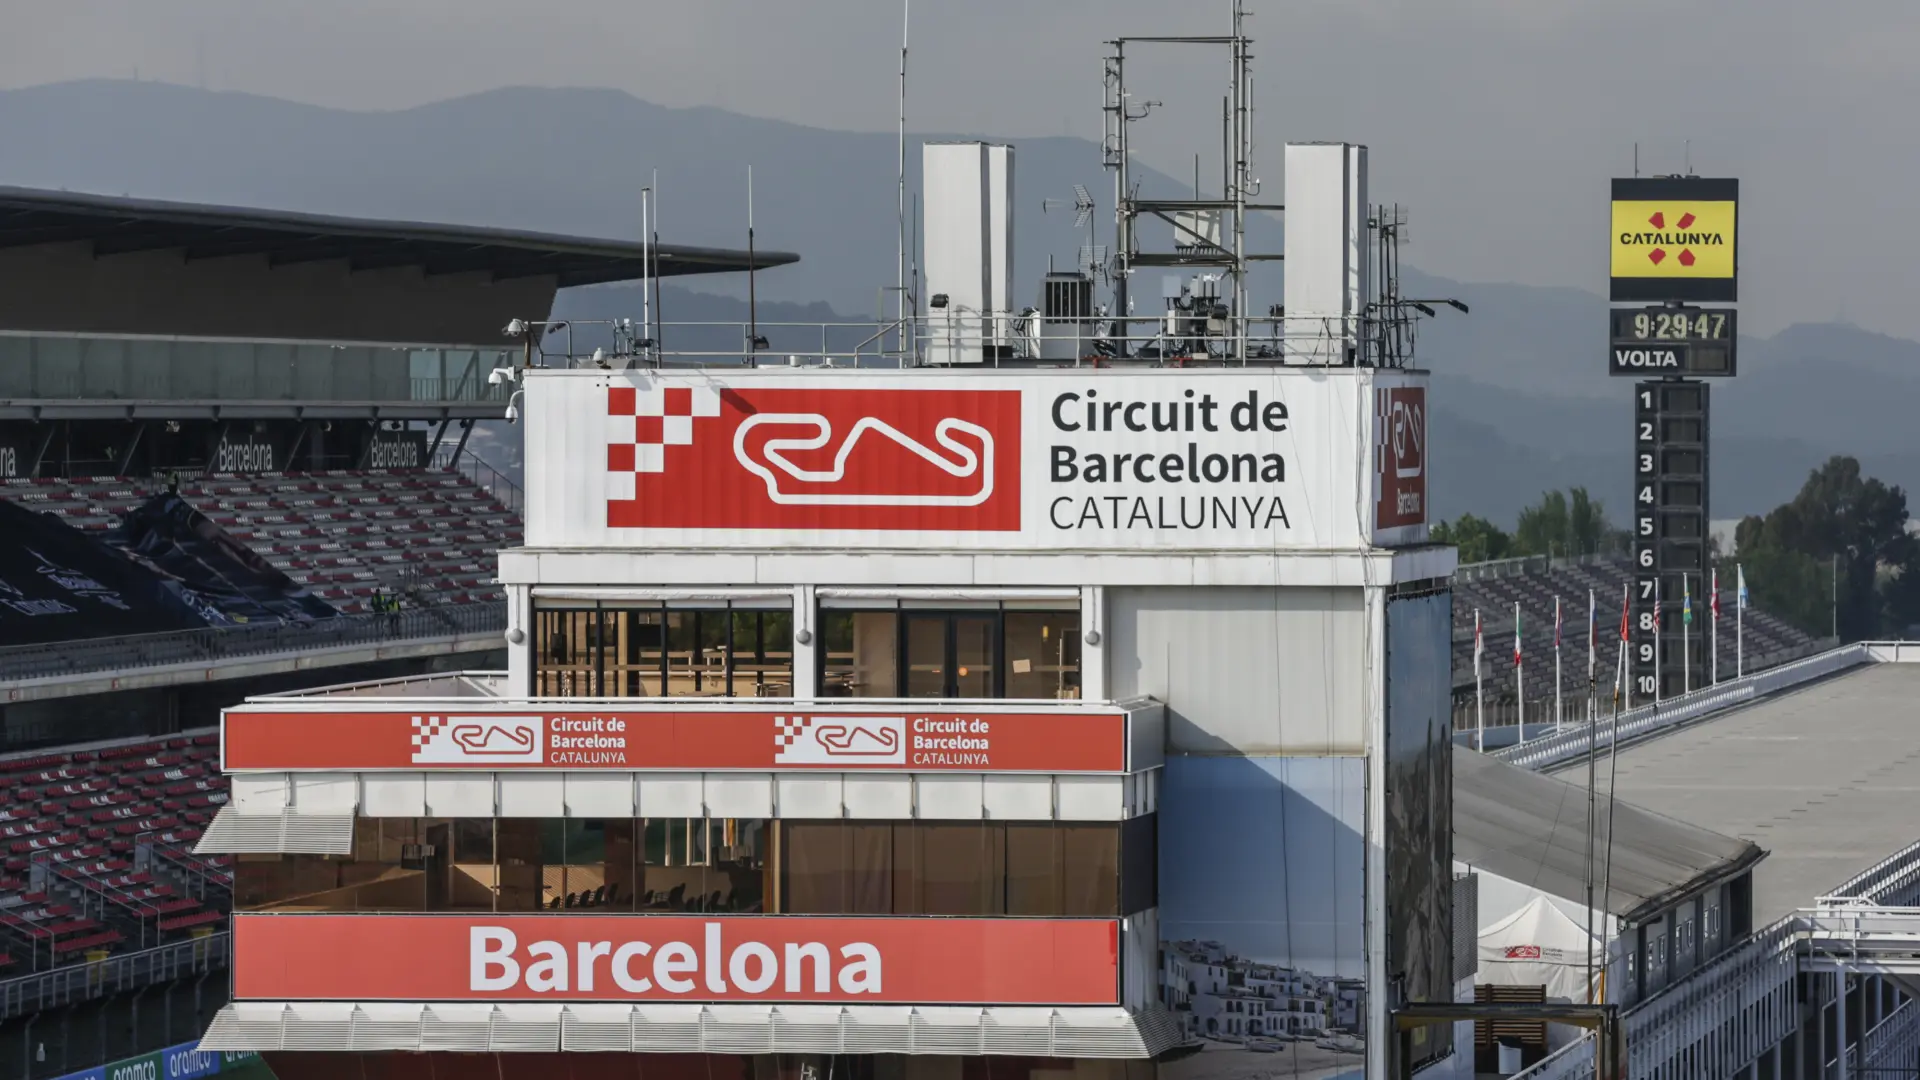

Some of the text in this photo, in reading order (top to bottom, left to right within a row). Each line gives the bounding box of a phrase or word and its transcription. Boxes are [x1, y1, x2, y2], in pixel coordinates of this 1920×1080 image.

[1620, 233, 1723, 245] CATALUNYA
[1634, 313, 1726, 339] 9:29:47
[1615, 350, 1678, 367] VOLTA
[1640, 391, 1651, 409] 1
[1051, 389, 1289, 432] Circuit de
[1640, 422, 1653, 440] 2
[219, 434, 273, 472] Barcelona
[371, 433, 418, 468] Barcelona
[1050, 442, 1285, 483] Barcelona
[1640, 454, 1653, 472] 3
[1639, 486, 1654, 503] 4
[1050, 496, 1291, 530] CATALUNYA
[1640, 518, 1653, 535] 5
[1640, 549, 1654, 567] 6
[1640, 581, 1653, 598] 7
[1639, 612, 1653, 630] 8
[1640, 644, 1653, 662] 9
[1637, 675, 1656, 693] 10
[550, 717, 626, 732] Circuit de
[913, 718, 989, 733] Circuit de
[551, 734, 626, 748] Barcelona
[913, 735, 989, 750] Barcelona
[550, 752, 626, 763] CATALUNYA
[913, 753, 989, 765] CATALUNYA
[470, 922, 882, 994] Barcelona
[170, 1049, 211, 1077] aramco
